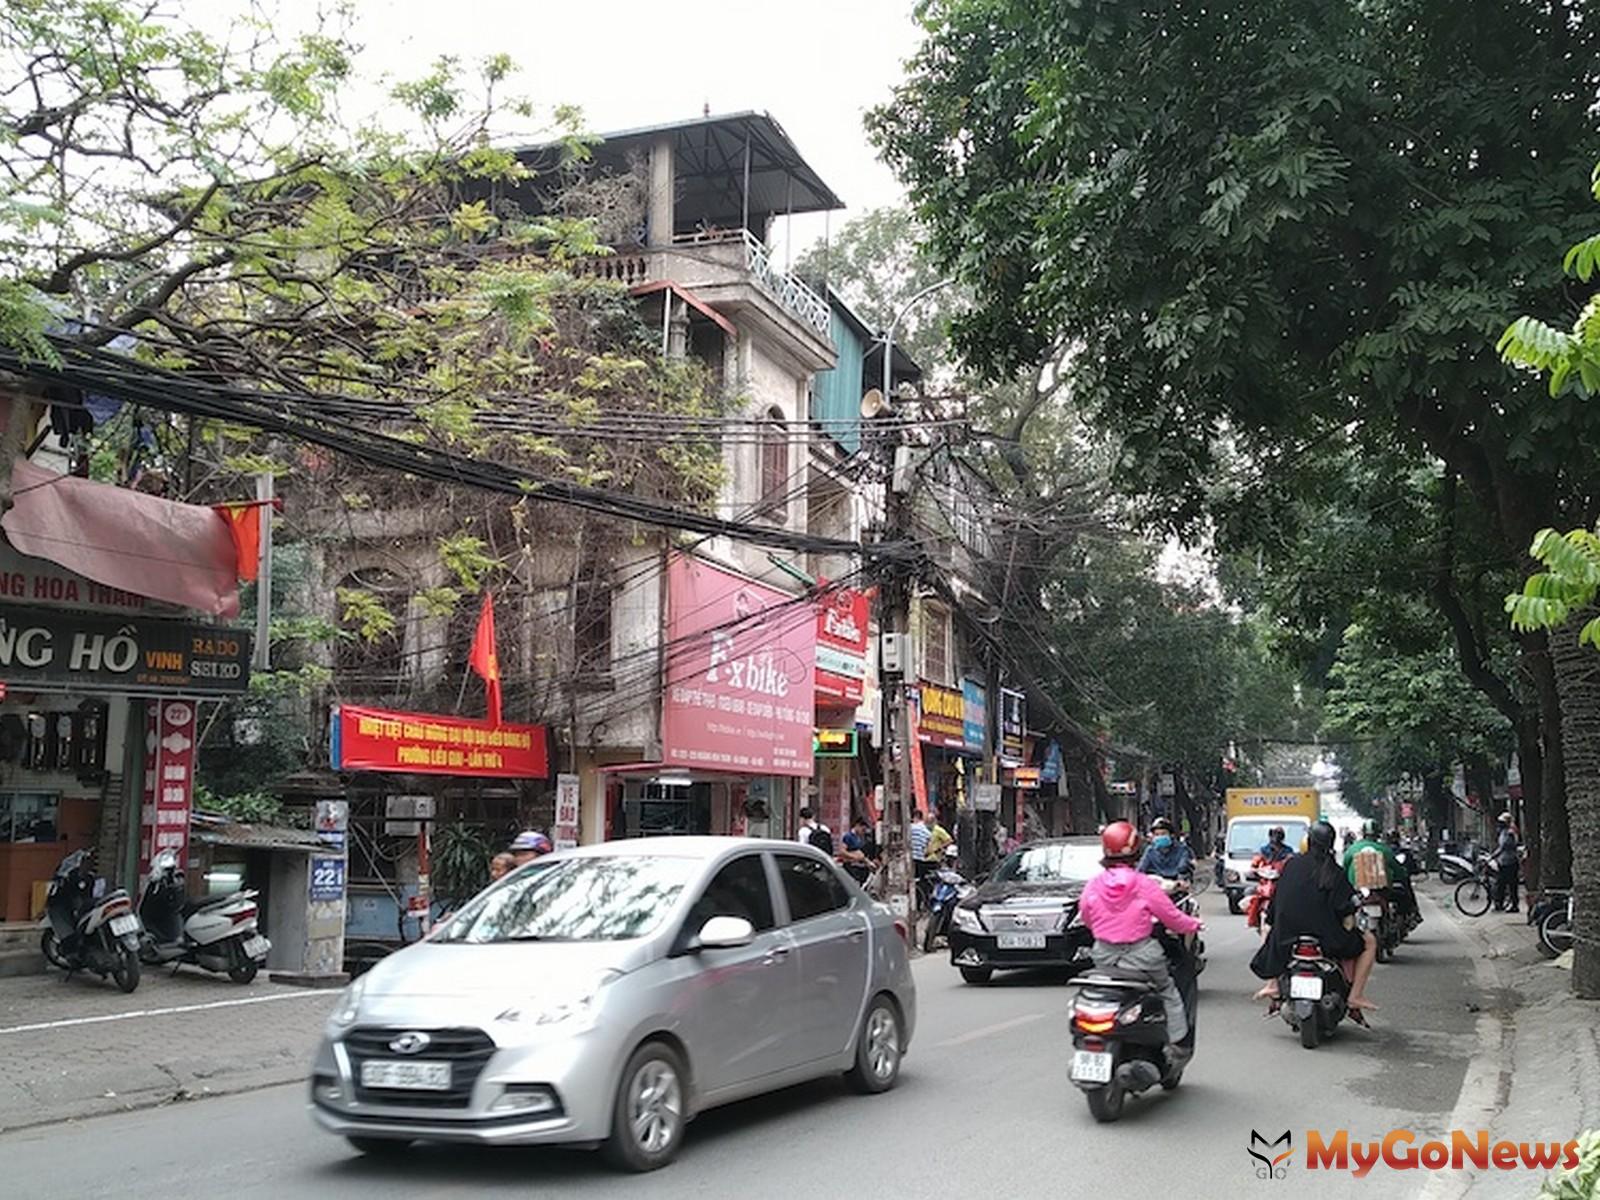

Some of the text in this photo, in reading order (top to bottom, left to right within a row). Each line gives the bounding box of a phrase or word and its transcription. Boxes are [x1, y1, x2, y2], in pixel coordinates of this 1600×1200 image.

[33, 575, 80, 601] HOA
[69, 623, 139, 673] HỒ
[145, 651, 183, 670] VINH
[190, 660, 241, 679] SEIKO
[313, 868, 343, 886] 221
